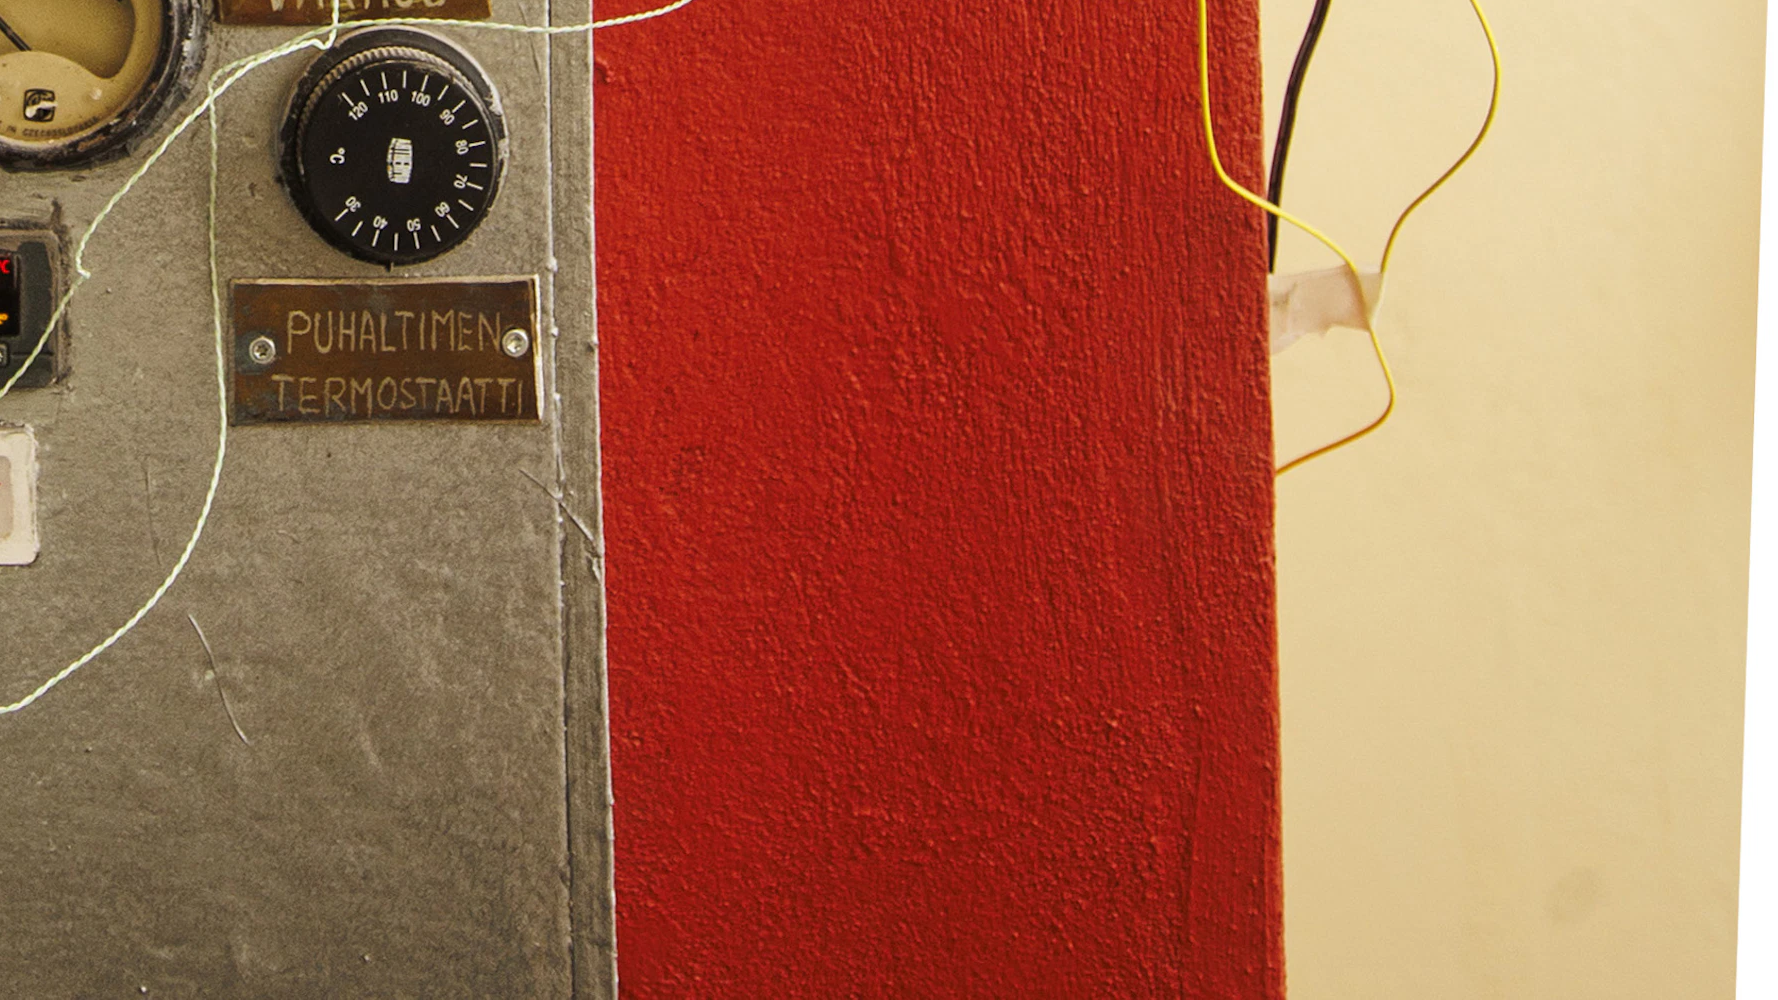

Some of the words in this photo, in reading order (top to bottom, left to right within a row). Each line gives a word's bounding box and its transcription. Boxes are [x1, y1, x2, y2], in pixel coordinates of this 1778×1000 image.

[377, 89, 399, 104] 110
[411, 90, 431, 107] 100
[348, 101, 369, 121] 120
[439, 109, 455, 125] 90
[455, 139, 469, 155] 80
[453, 174, 468, 189] 70
[345, 196, 362, 212] 30
[434, 201, 451, 218] 60
[373, 215, 389, 230] 40
[406, 218, 421, 232] 50
[286, 307, 502, 355] PUHALTIMEN
[270, 372, 524, 417] TERMOSTAATTI
